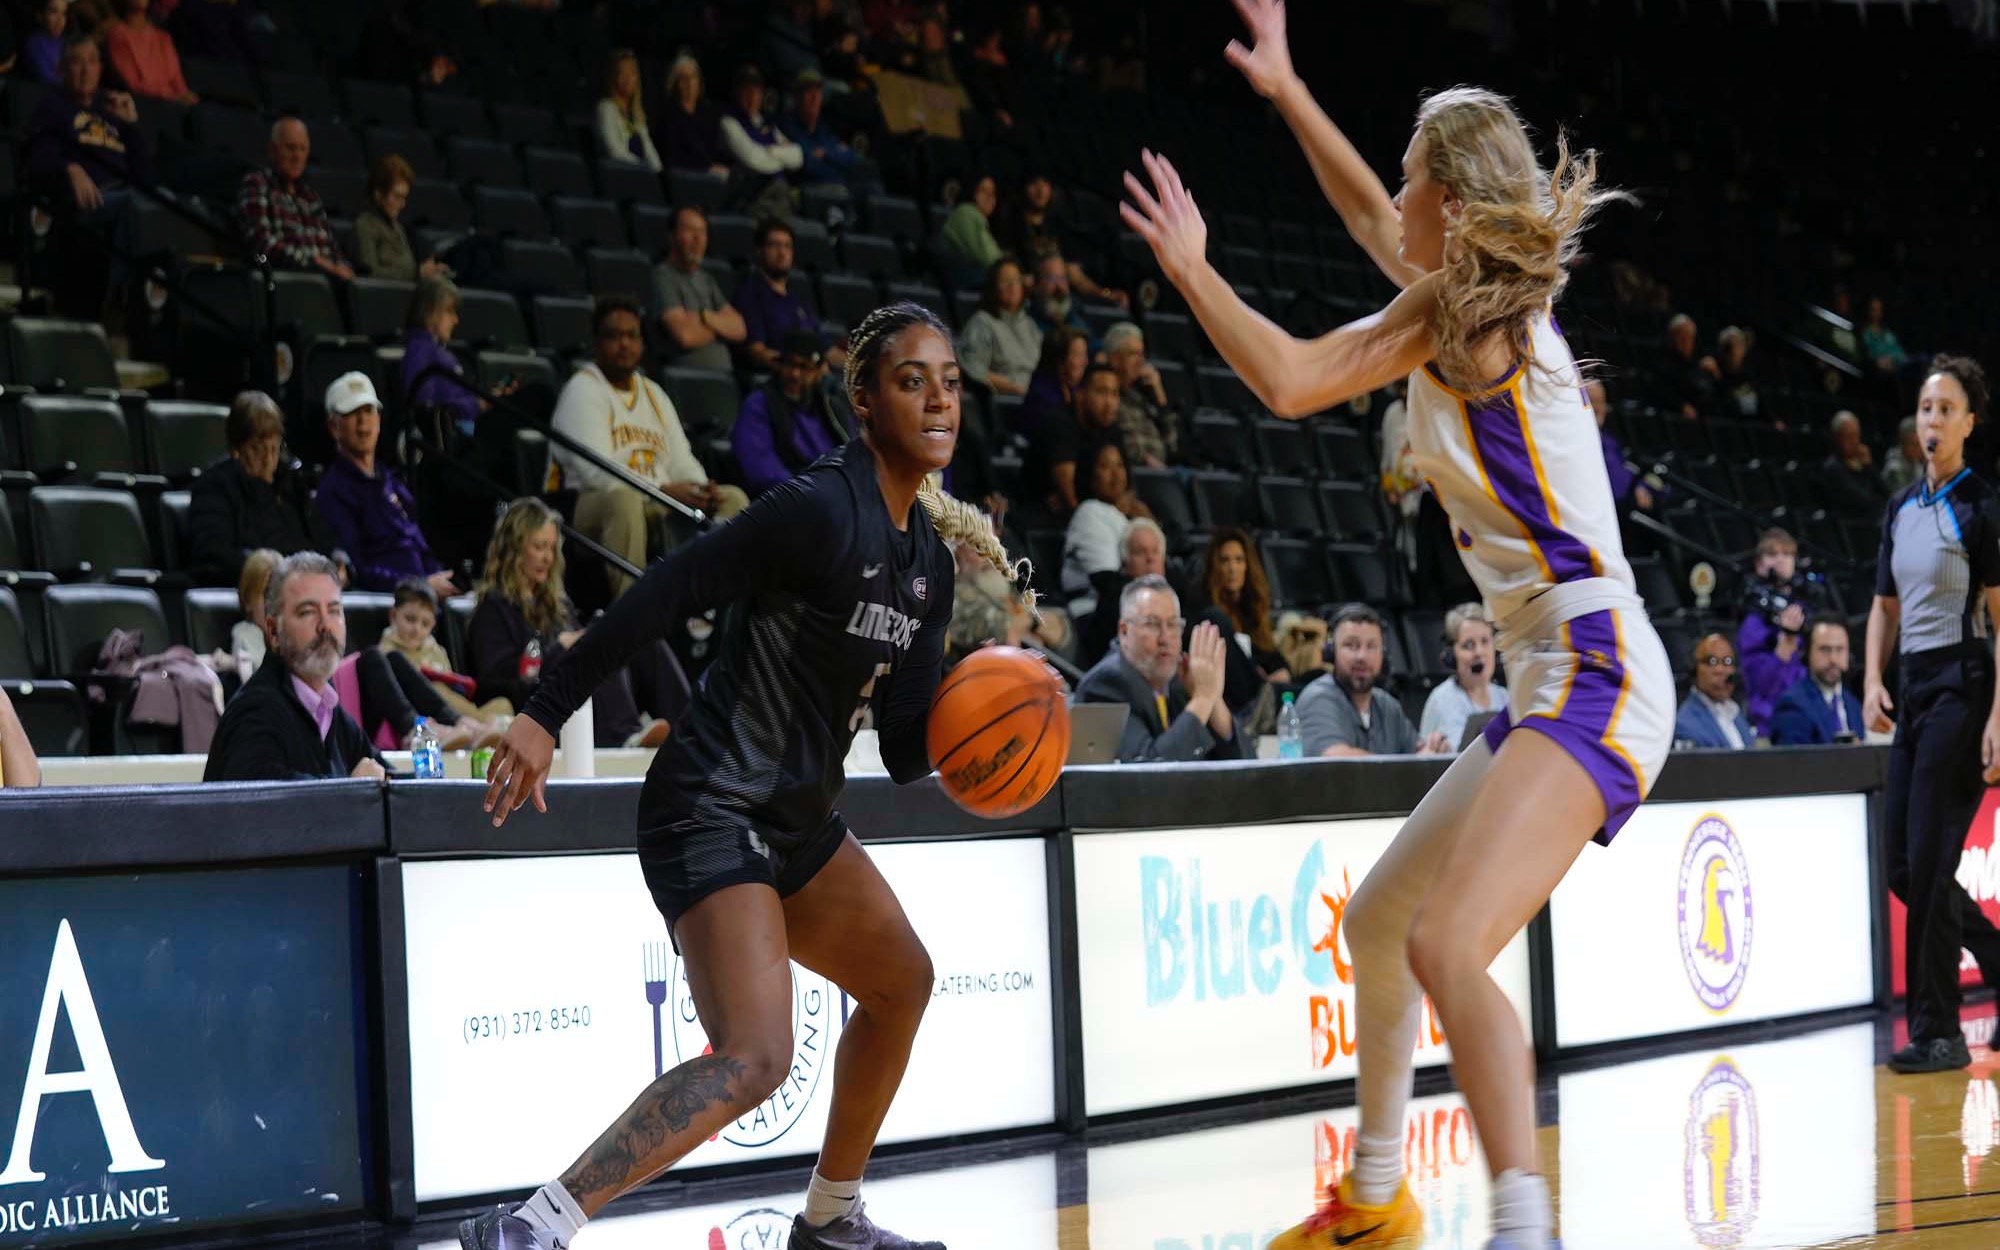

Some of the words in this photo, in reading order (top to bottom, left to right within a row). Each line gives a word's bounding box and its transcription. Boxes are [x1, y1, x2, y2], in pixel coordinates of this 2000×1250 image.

[0, 917, 166, 1185] A
[463, 1014, 506, 1045] (931)
[43, 1185, 170, 1229] ALLIANCE
